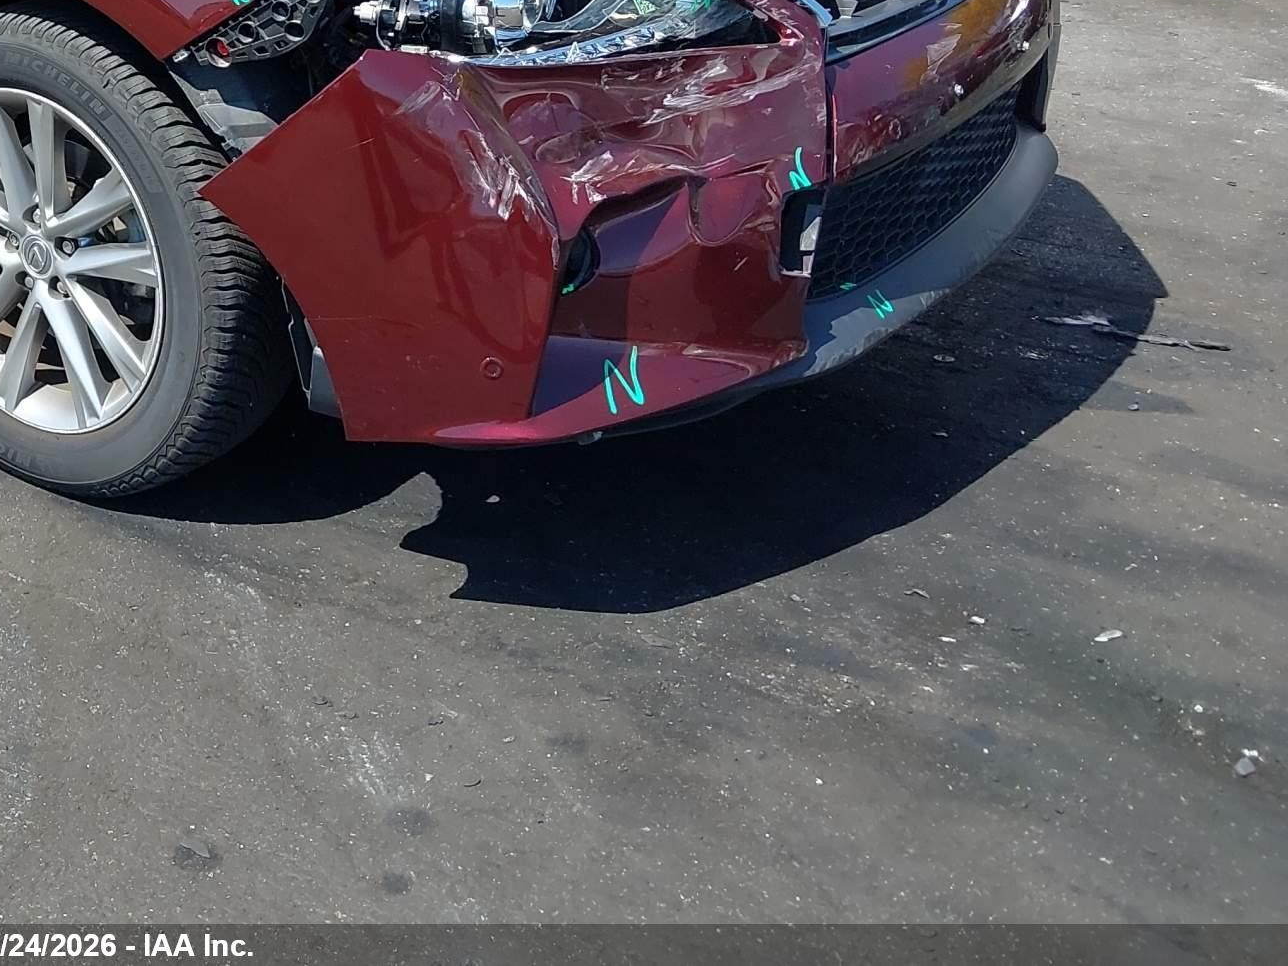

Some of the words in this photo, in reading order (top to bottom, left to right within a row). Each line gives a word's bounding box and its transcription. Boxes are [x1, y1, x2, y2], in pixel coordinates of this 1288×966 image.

[5, 51, 108, 116] MICHELIN
[788, 146, 812, 191] N
[866, 289, 894, 320] N
[603, 345, 646, 415] N
